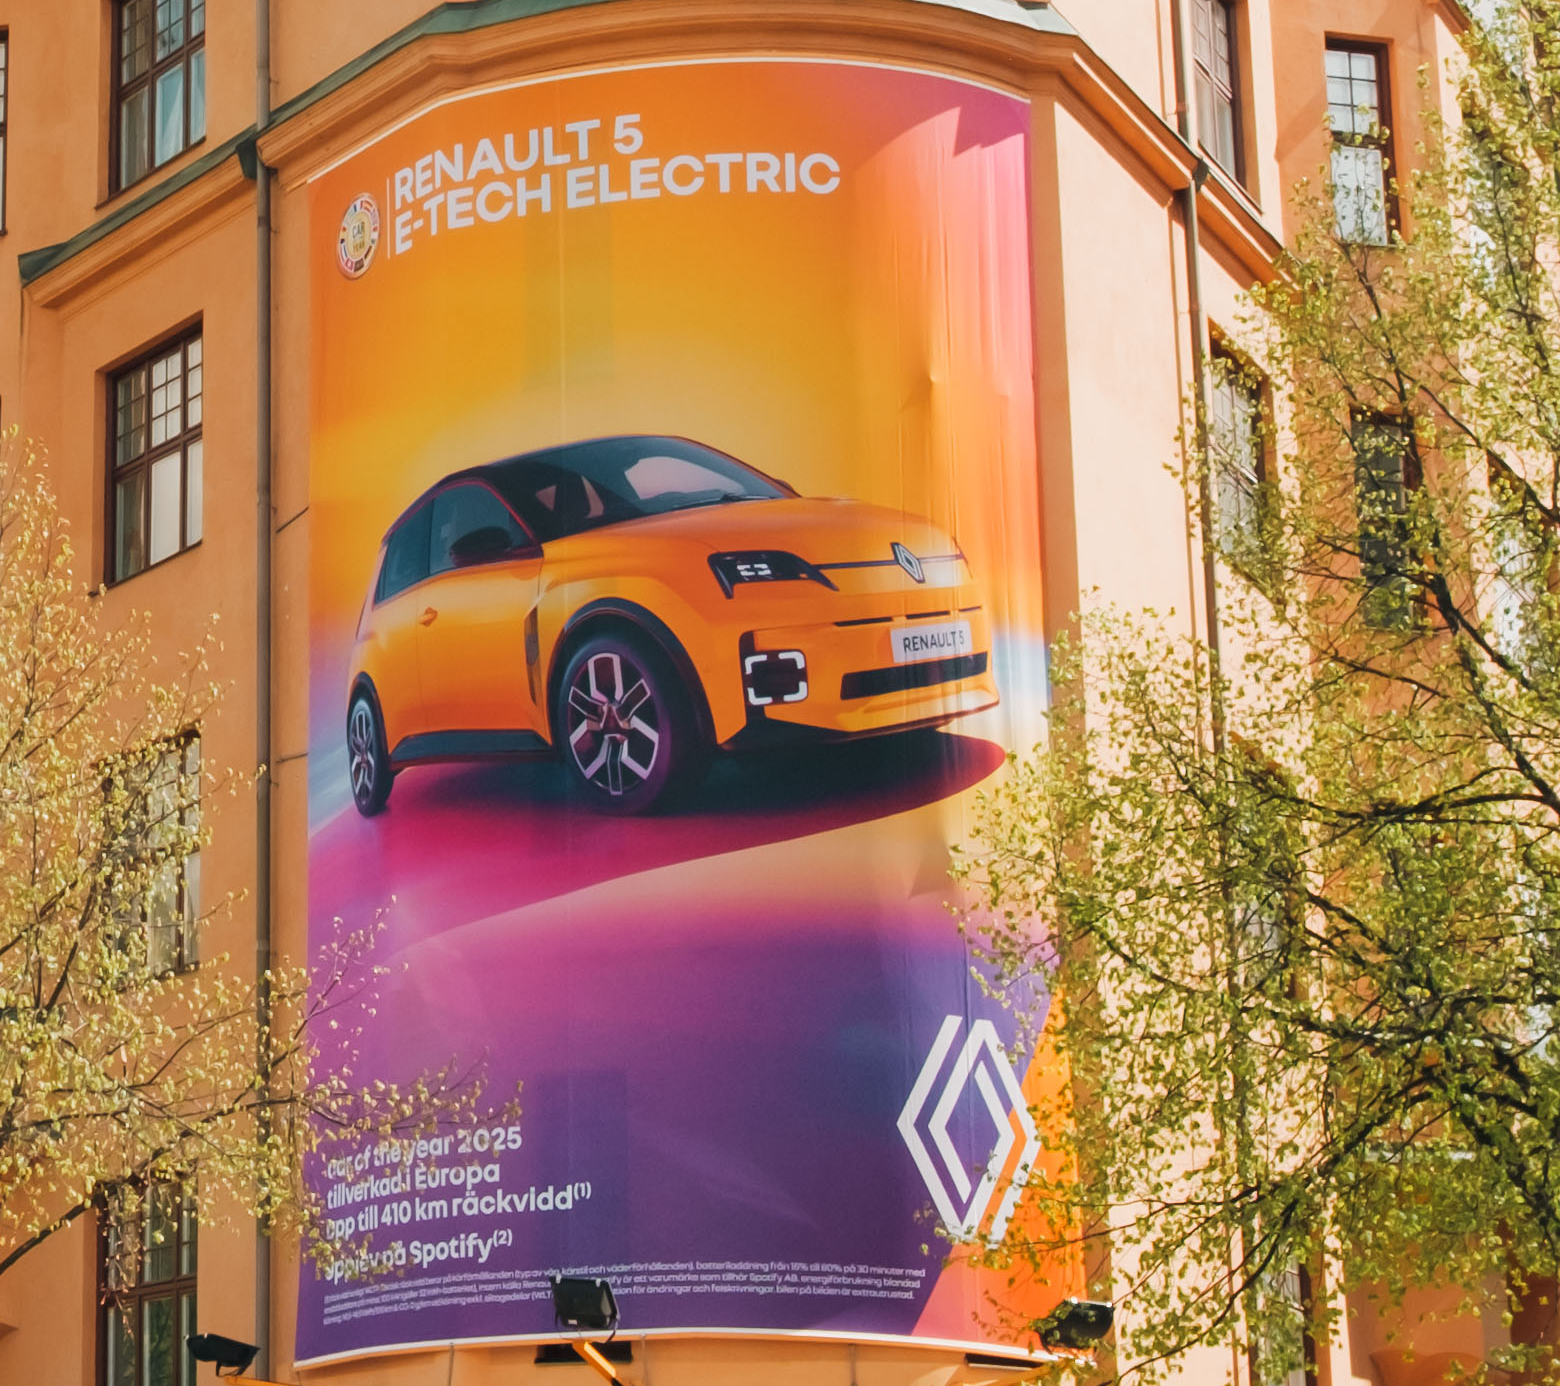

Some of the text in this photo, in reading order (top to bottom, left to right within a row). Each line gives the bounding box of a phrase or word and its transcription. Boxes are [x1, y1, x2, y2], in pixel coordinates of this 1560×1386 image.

[394, 113, 643, 211] RENAULT 5
[395, 152, 840, 255] E-TECH ELECTRIC
[903, 630, 964, 653] RENAULT 5
[354, 1144, 371, 1171] of
[373, 1140, 401, 1166] the
[403, 1134, 453, 1166] year
[458, 1126, 523, 1153] 2025
[327, 1170, 401, 1209] tillverkad
[415, 1163, 500, 1190] Europa
[357, 1205, 378, 1231] till
[381, 1199, 411, 1226] 410
[415, 1195, 448, 1221] km
